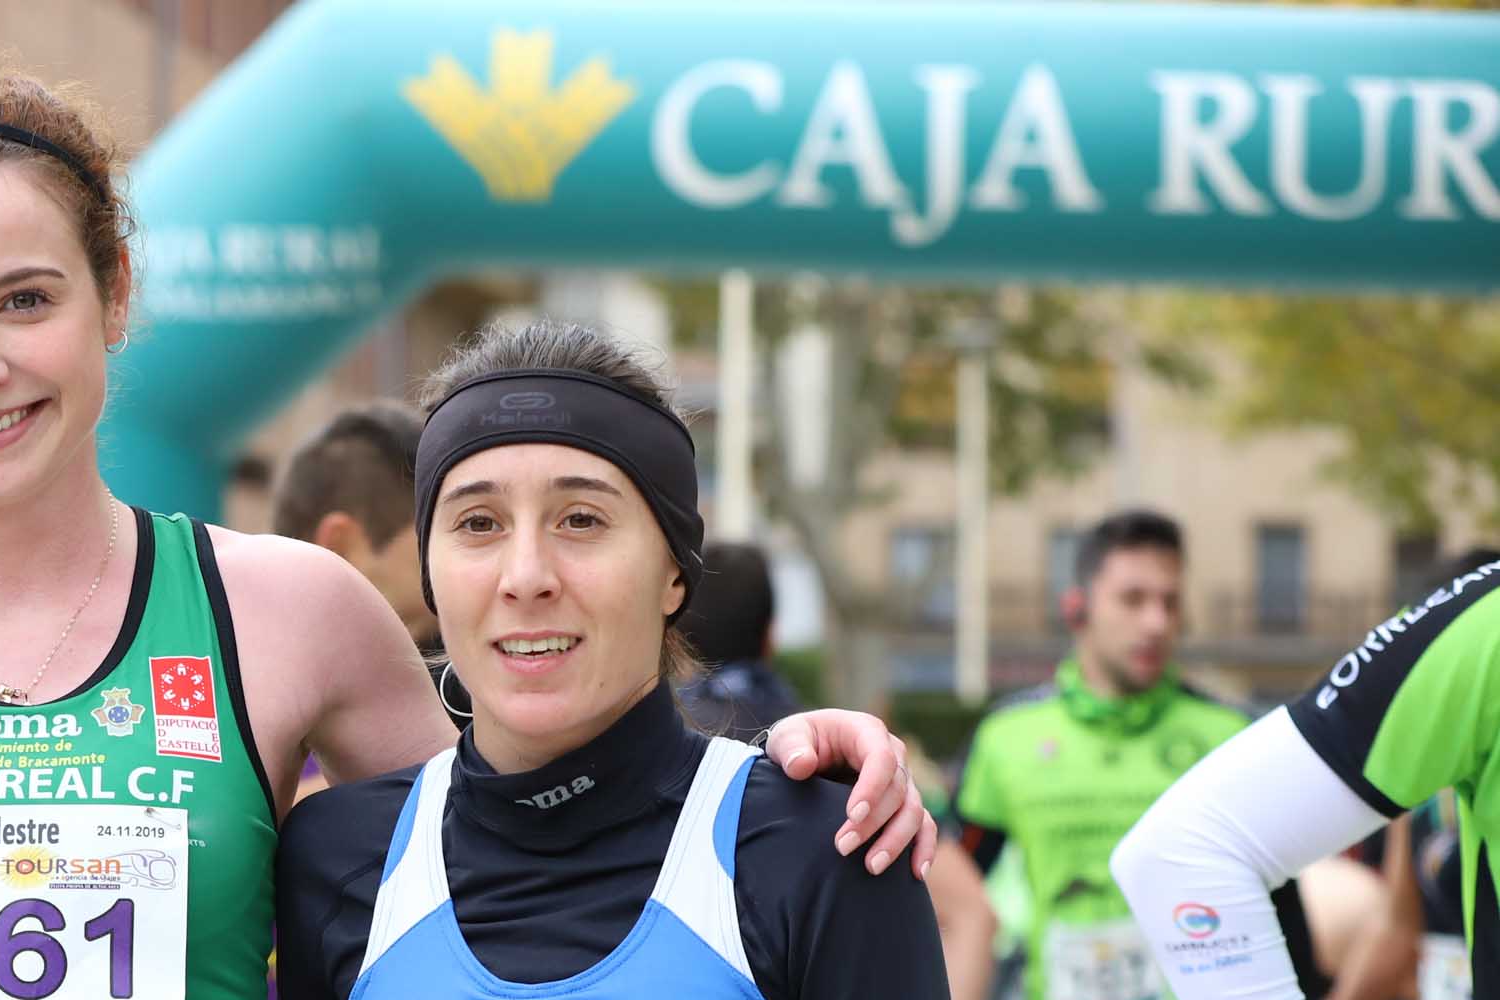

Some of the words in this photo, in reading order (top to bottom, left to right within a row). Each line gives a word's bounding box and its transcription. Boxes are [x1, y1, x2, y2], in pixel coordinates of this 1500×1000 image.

[649, 57, 1098, 246] CAJA
[53, 739, 73, 751] de
[17, 753, 106, 768] Bracamonte
[127, 766, 195, 804] C.F
[97, 825, 165, 839] 24.11.2019
